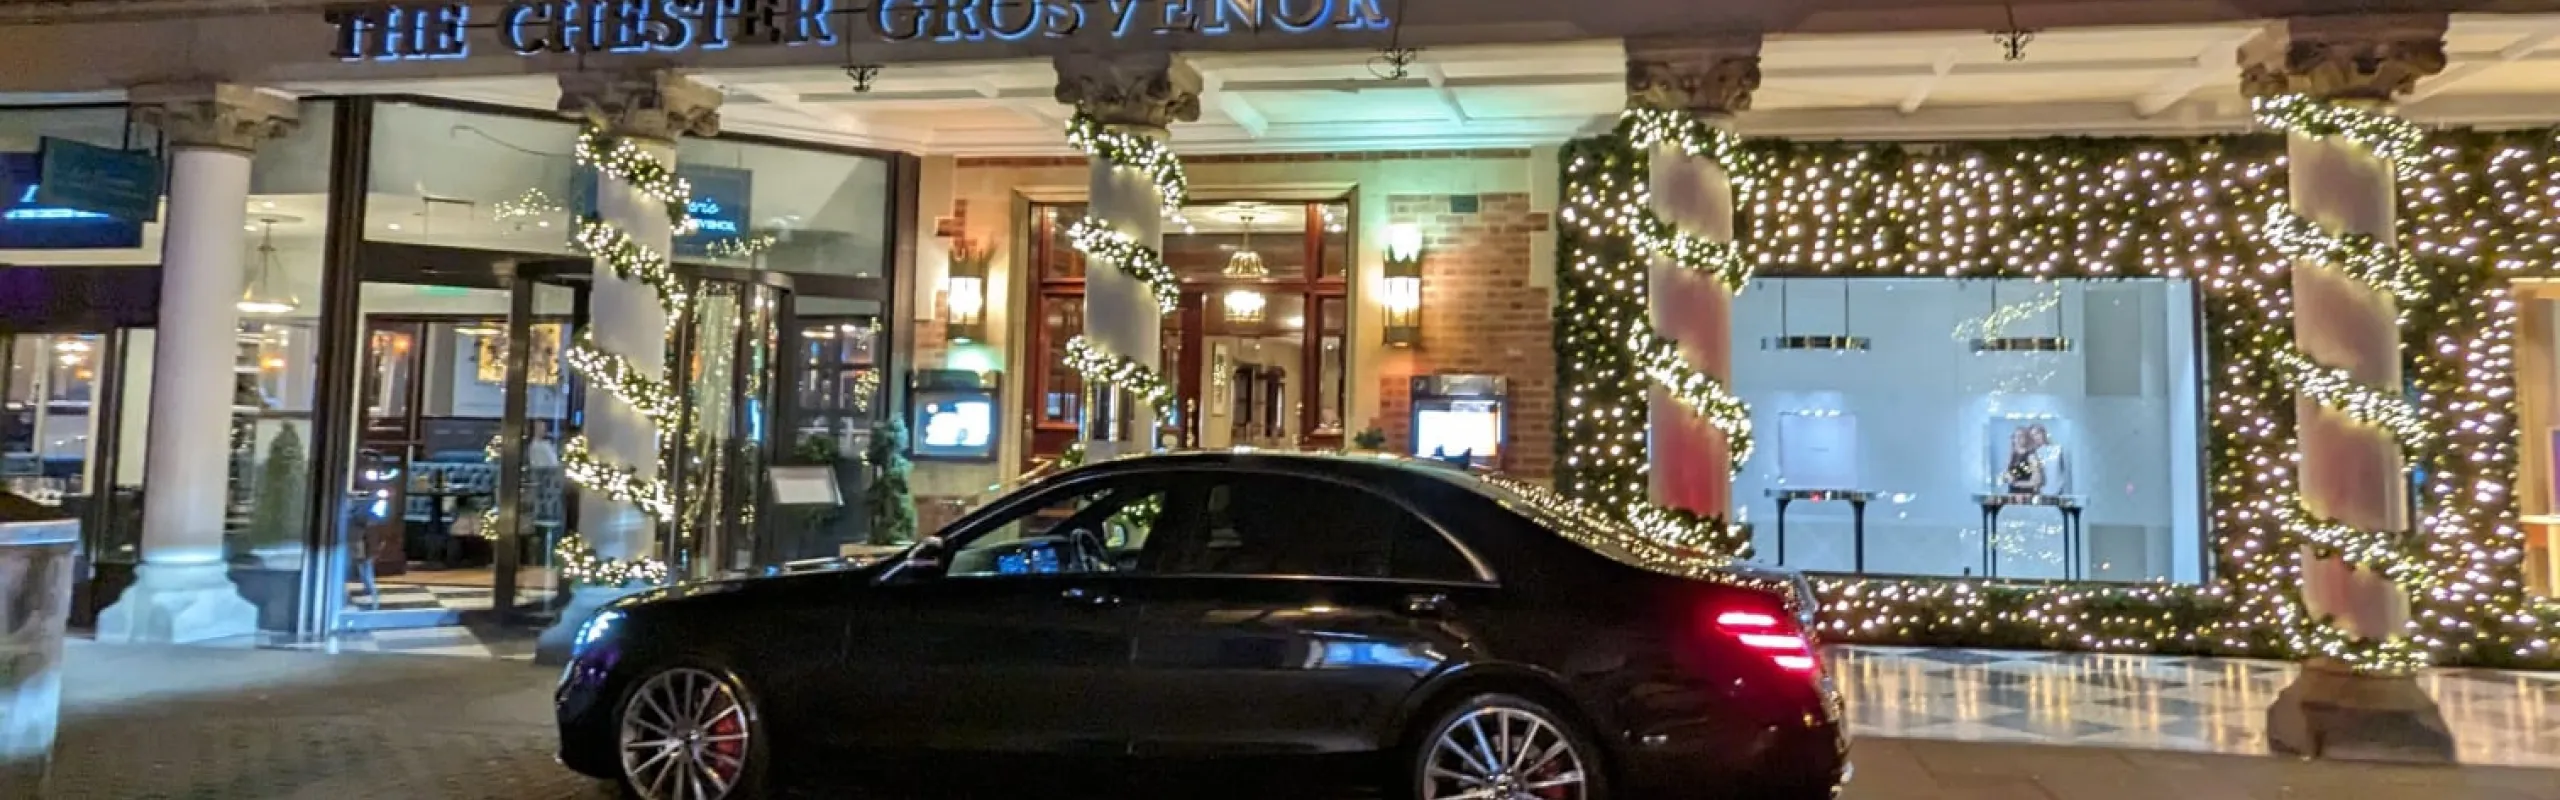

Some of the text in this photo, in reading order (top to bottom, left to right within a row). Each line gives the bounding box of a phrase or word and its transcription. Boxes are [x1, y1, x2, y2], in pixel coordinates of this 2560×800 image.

[324, 0, 1390, 63] THE CHESTER GROSVENOR
